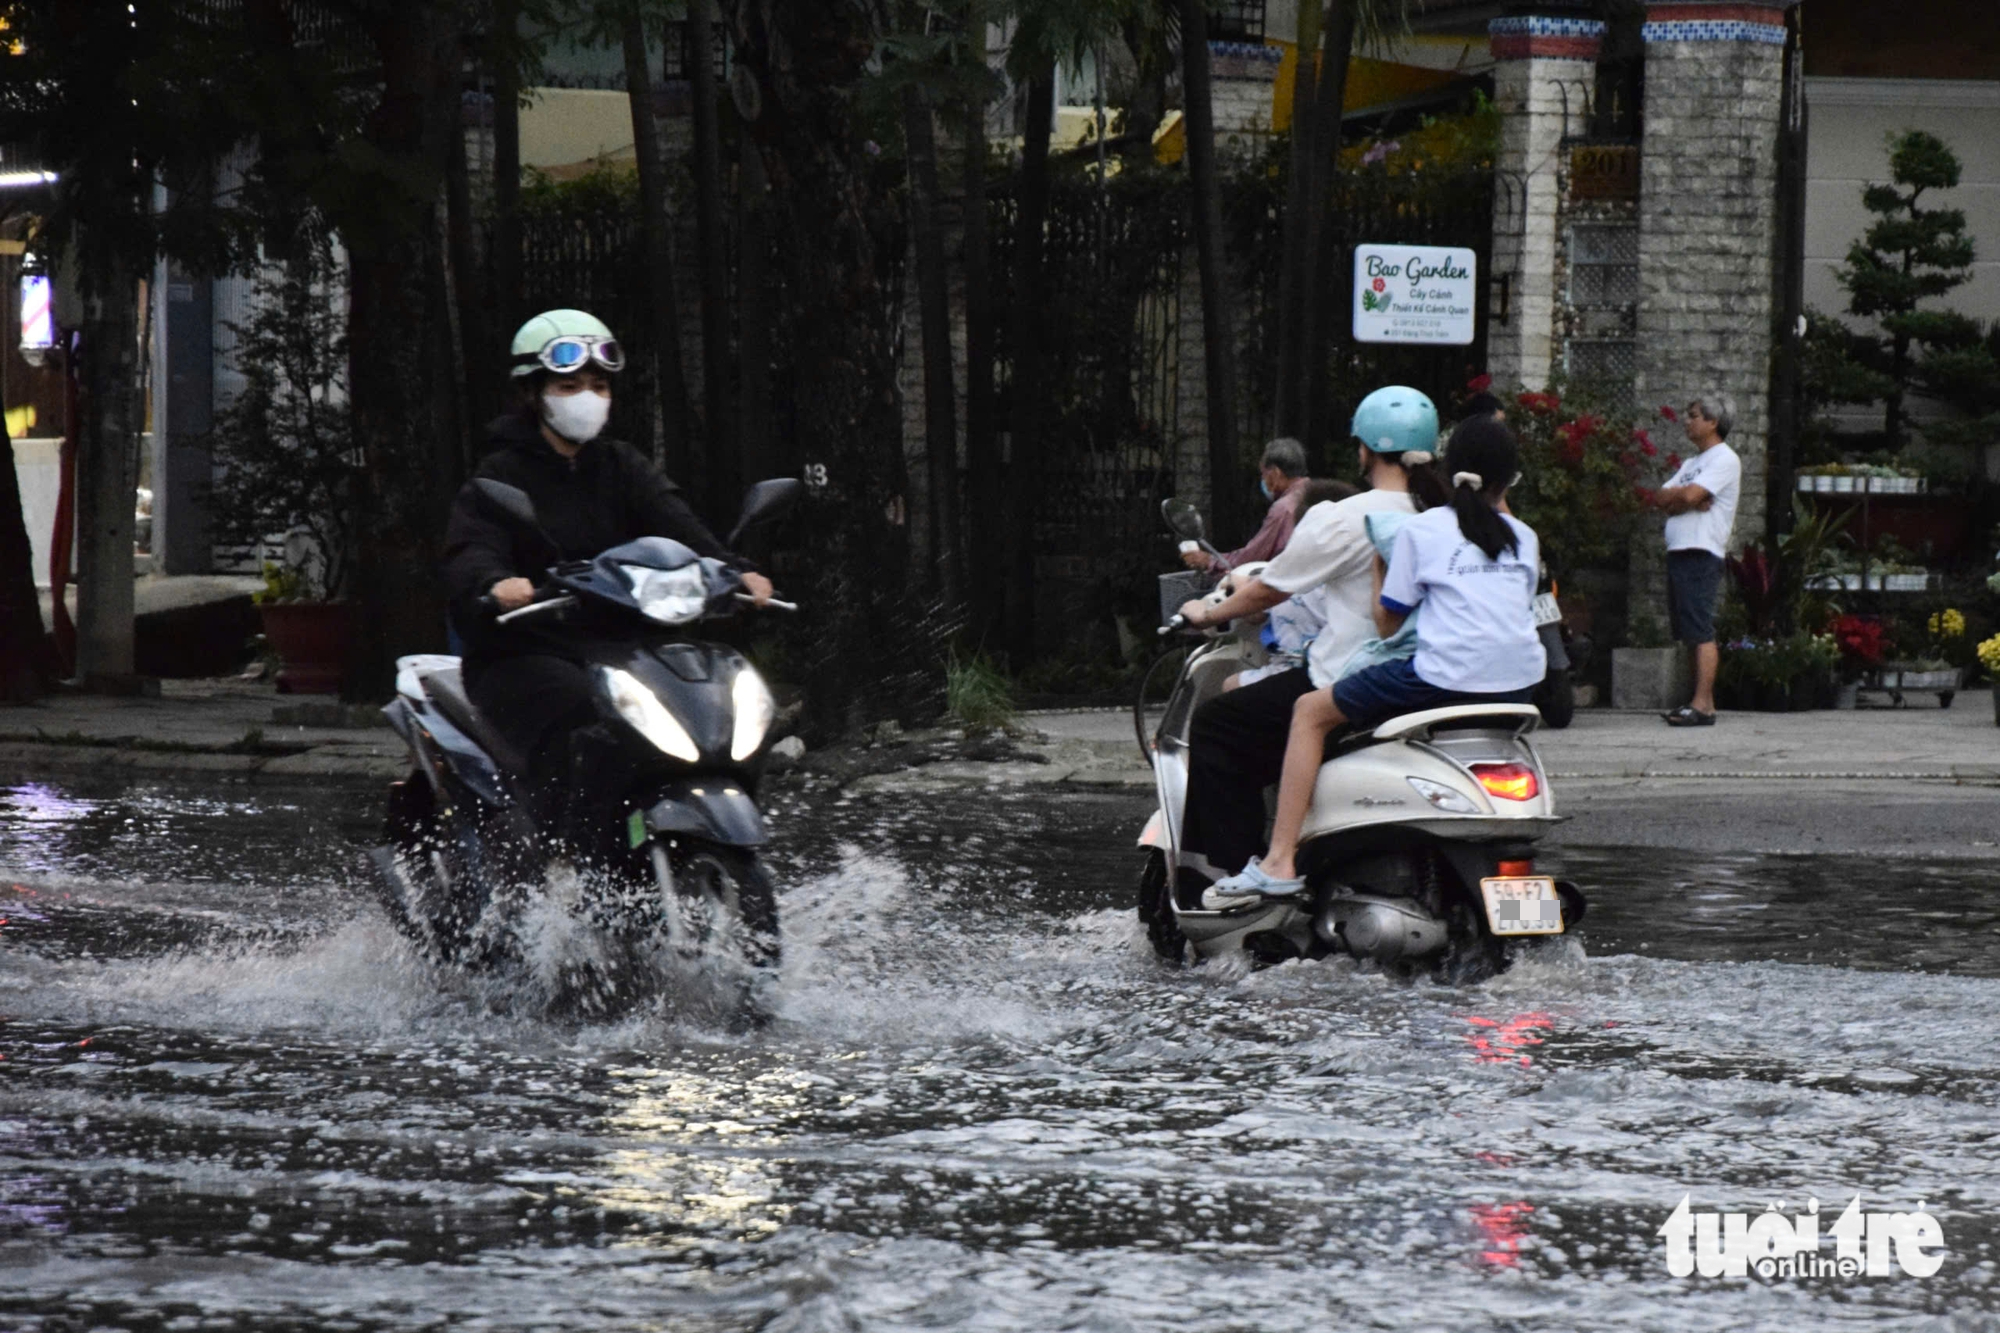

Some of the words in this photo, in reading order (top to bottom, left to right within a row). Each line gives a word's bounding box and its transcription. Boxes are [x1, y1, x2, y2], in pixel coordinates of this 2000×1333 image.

[1580, 151, 1627, 175] 201
[1366, 255, 1401, 277] Bao
[1406, 255, 1469, 286] Garden
